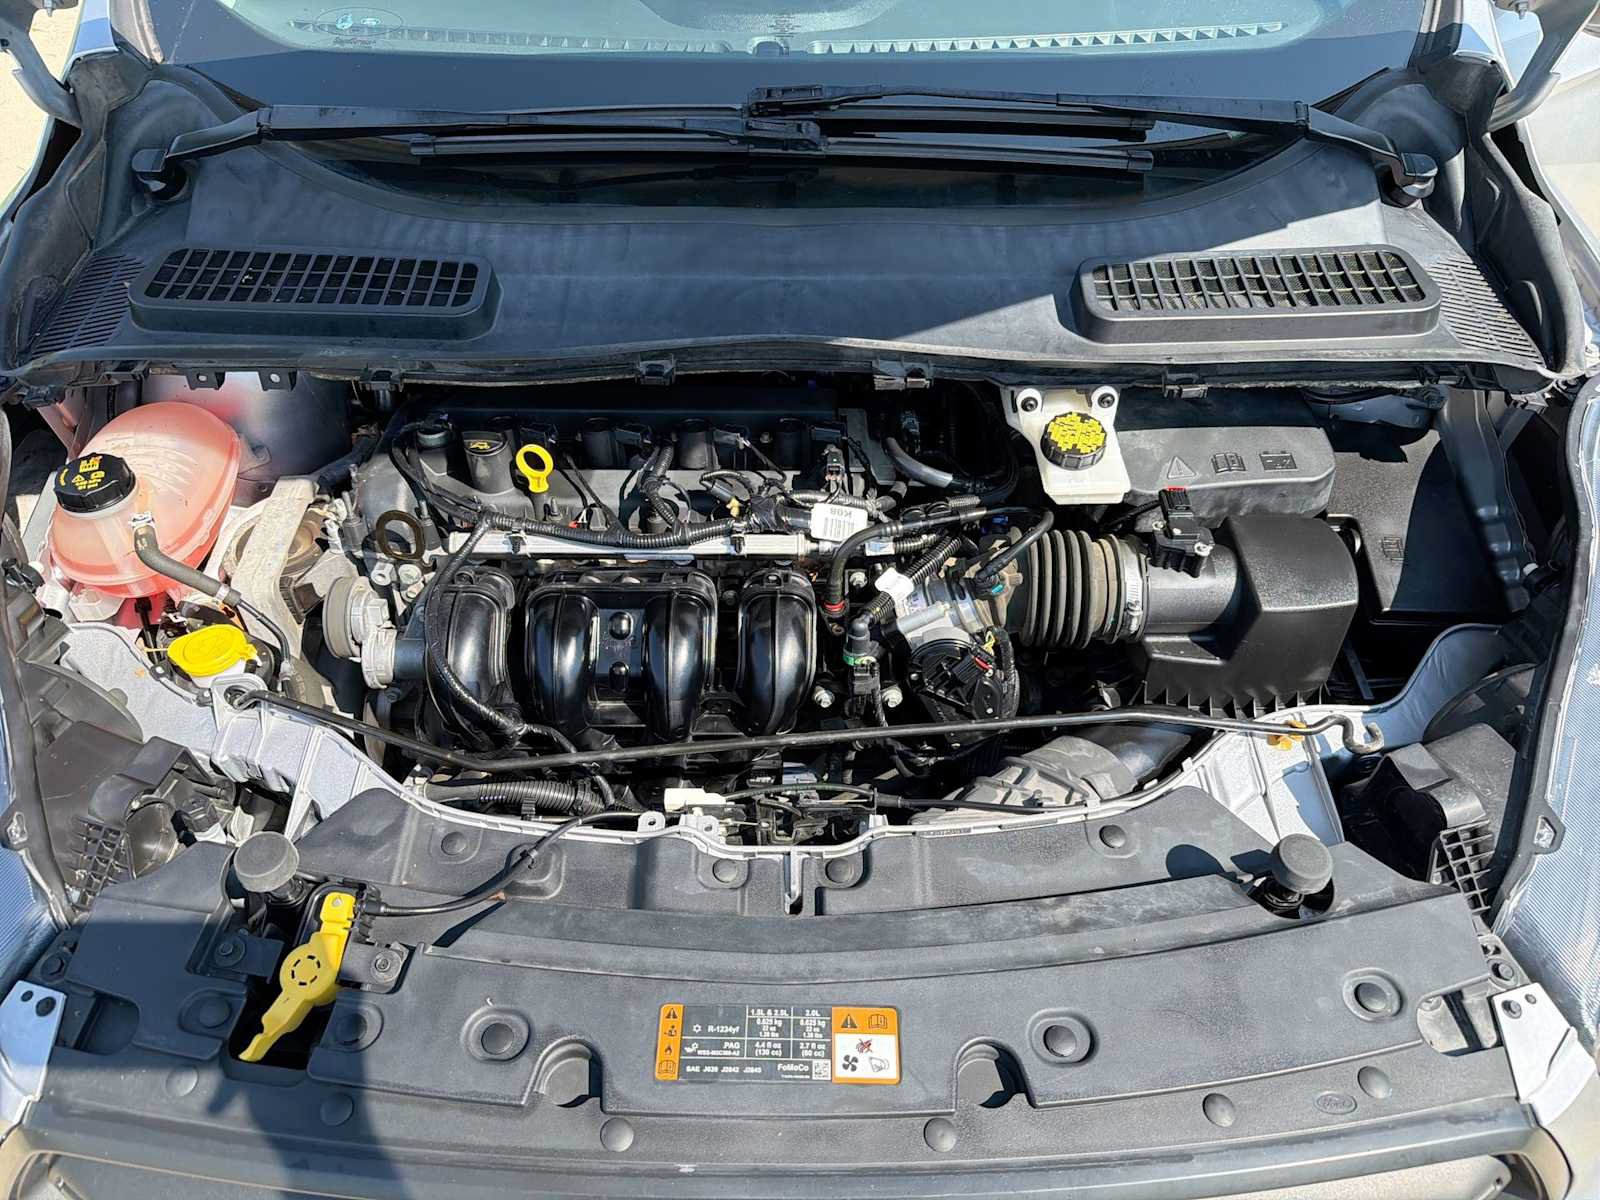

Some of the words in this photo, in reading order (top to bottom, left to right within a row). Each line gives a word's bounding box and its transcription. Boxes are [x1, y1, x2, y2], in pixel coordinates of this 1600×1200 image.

[805, 1009, 821, 1017] 2.0L
[774, 1018, 783, 1027] kg
[707, 1025, 740, 1034] R-1234yf
[777, 1063, 809, 1072] FoMoCo
